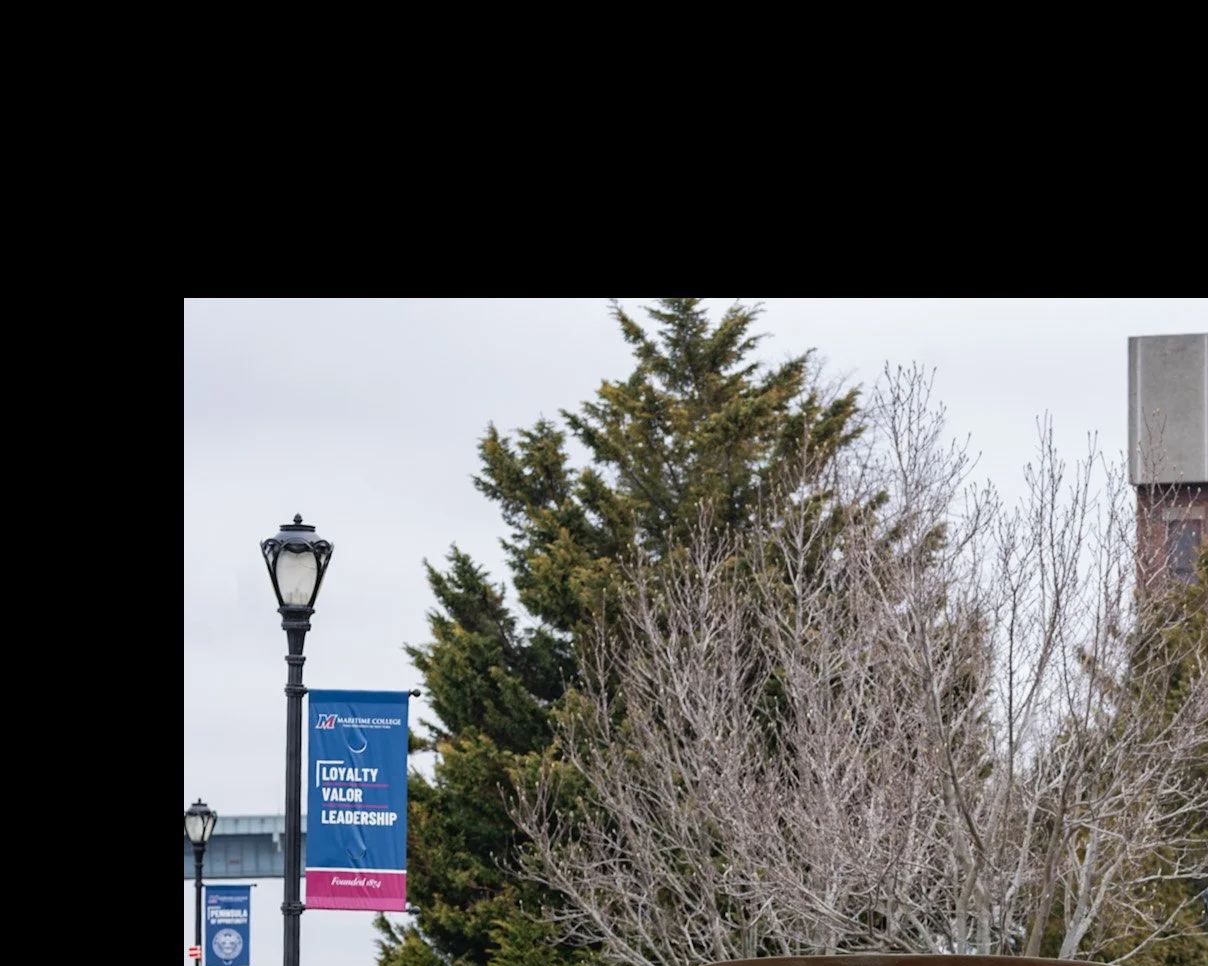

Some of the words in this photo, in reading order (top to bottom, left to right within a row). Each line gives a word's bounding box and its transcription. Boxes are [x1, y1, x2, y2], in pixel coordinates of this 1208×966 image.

[371, 718, 401, 726] COLLEGE
[322, 767, 378, 782] LOYALTY
[321, 787, 363, 802] VALOR
[321, 810, 397, 826] LEADERSHIP
[331, 876, 366, 887] Founded
